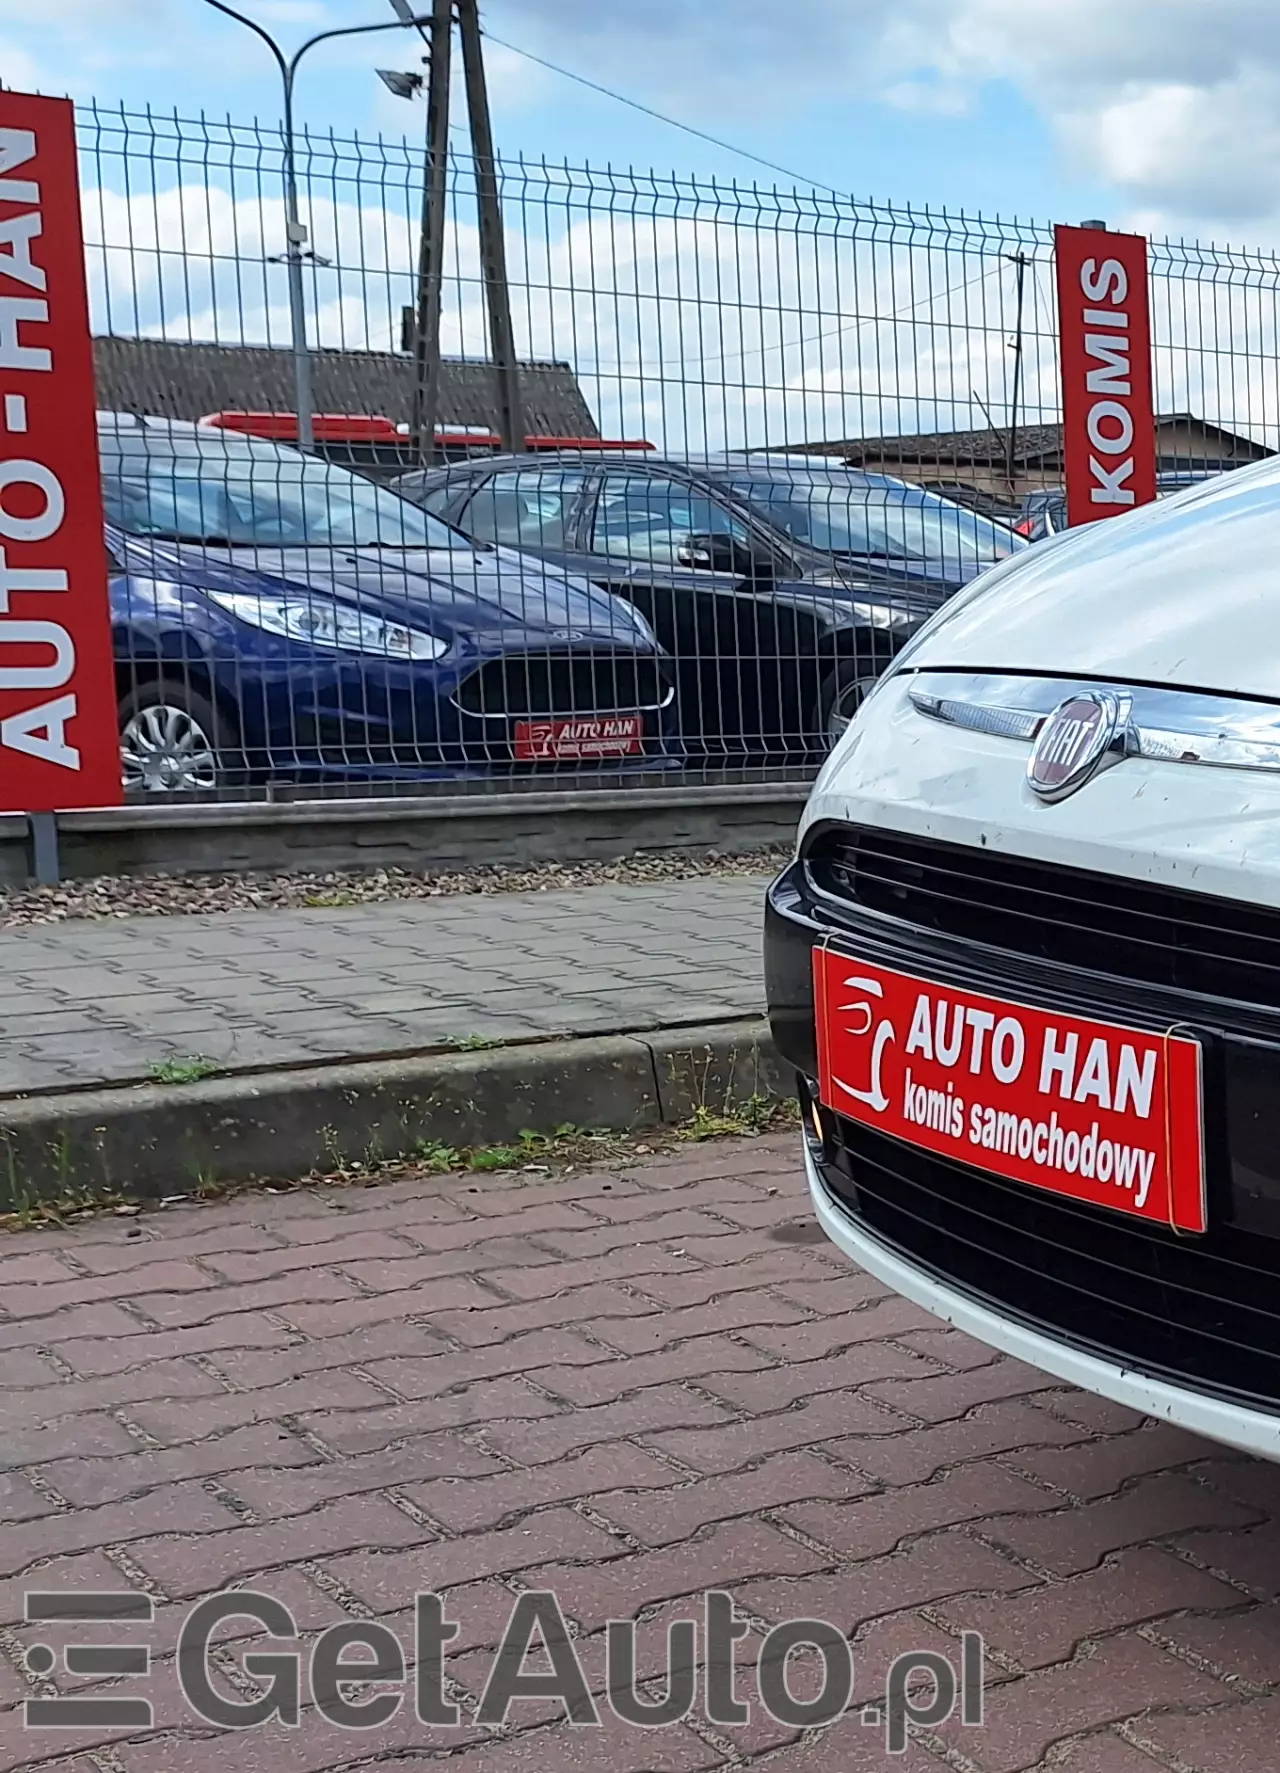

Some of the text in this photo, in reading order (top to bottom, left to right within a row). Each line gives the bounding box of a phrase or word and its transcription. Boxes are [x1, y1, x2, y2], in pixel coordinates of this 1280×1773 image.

[1080, 258, 1136, 505] KOMIS
[0, 458, 81, 771] AUTO
[559, 719, 634, 740] AUTO HAN
[1040, 718, 1095, 766] FIAT
[905, 994, 1158, 1119] AUTO HAN
[902, 1068, 1157, 1209] komis samochodowy
